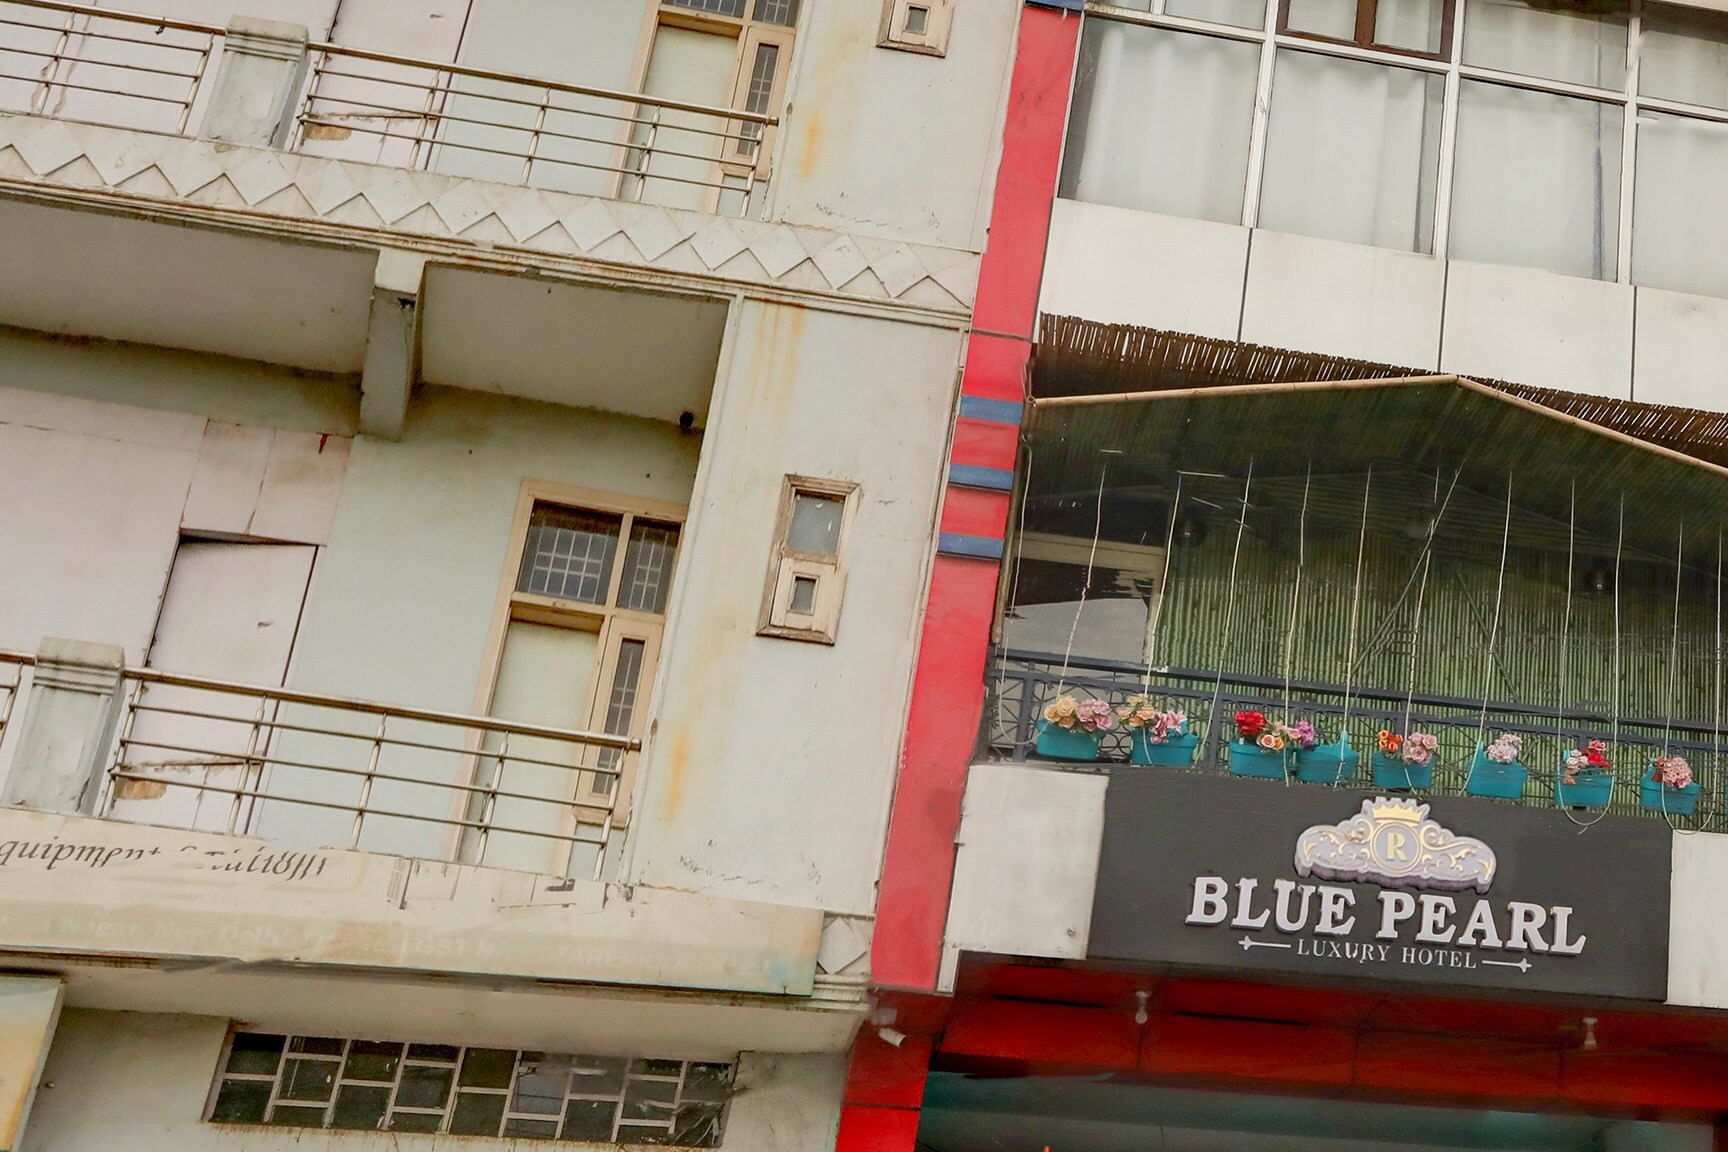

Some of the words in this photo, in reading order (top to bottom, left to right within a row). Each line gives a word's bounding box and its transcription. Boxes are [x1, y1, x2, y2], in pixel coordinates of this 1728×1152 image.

[1387, 830, 1405, 860] R
[1185, 875, 1357, 936] BLUE
[1375, 889, 1587, 955] PEARL
[1297, 938, 1391, 963] LUXURY
[1402, 947, 1477, 969] HOTEL
